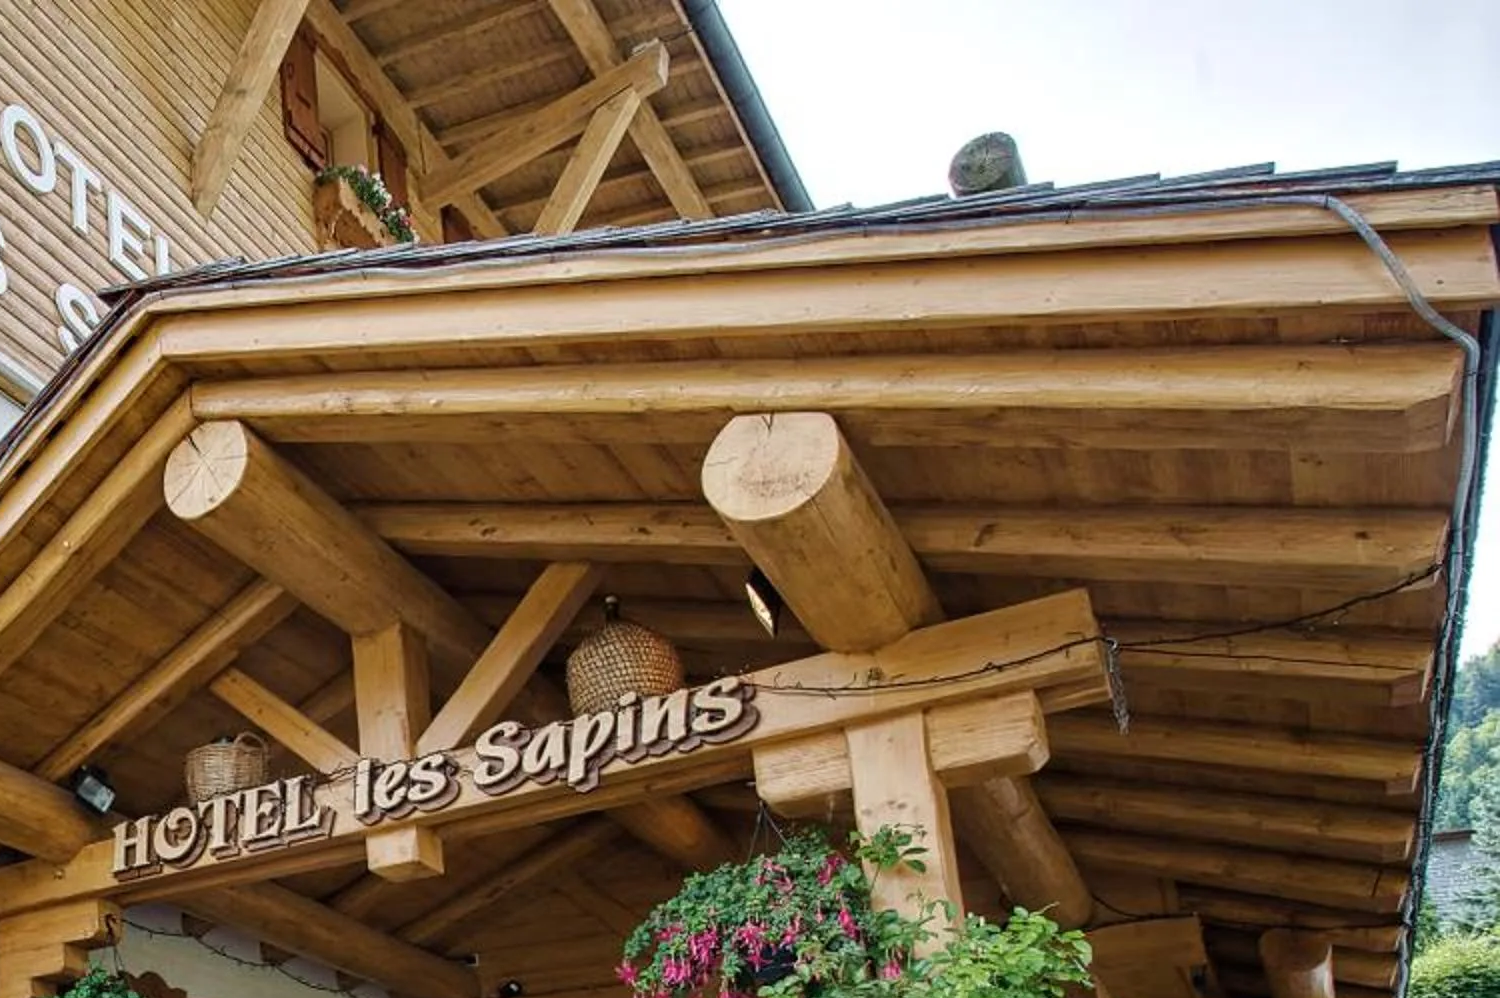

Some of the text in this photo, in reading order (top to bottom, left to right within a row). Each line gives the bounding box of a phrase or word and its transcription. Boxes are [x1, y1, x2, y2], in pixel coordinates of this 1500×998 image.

[112, 675, 746, 874] HOTEL les Sapins
